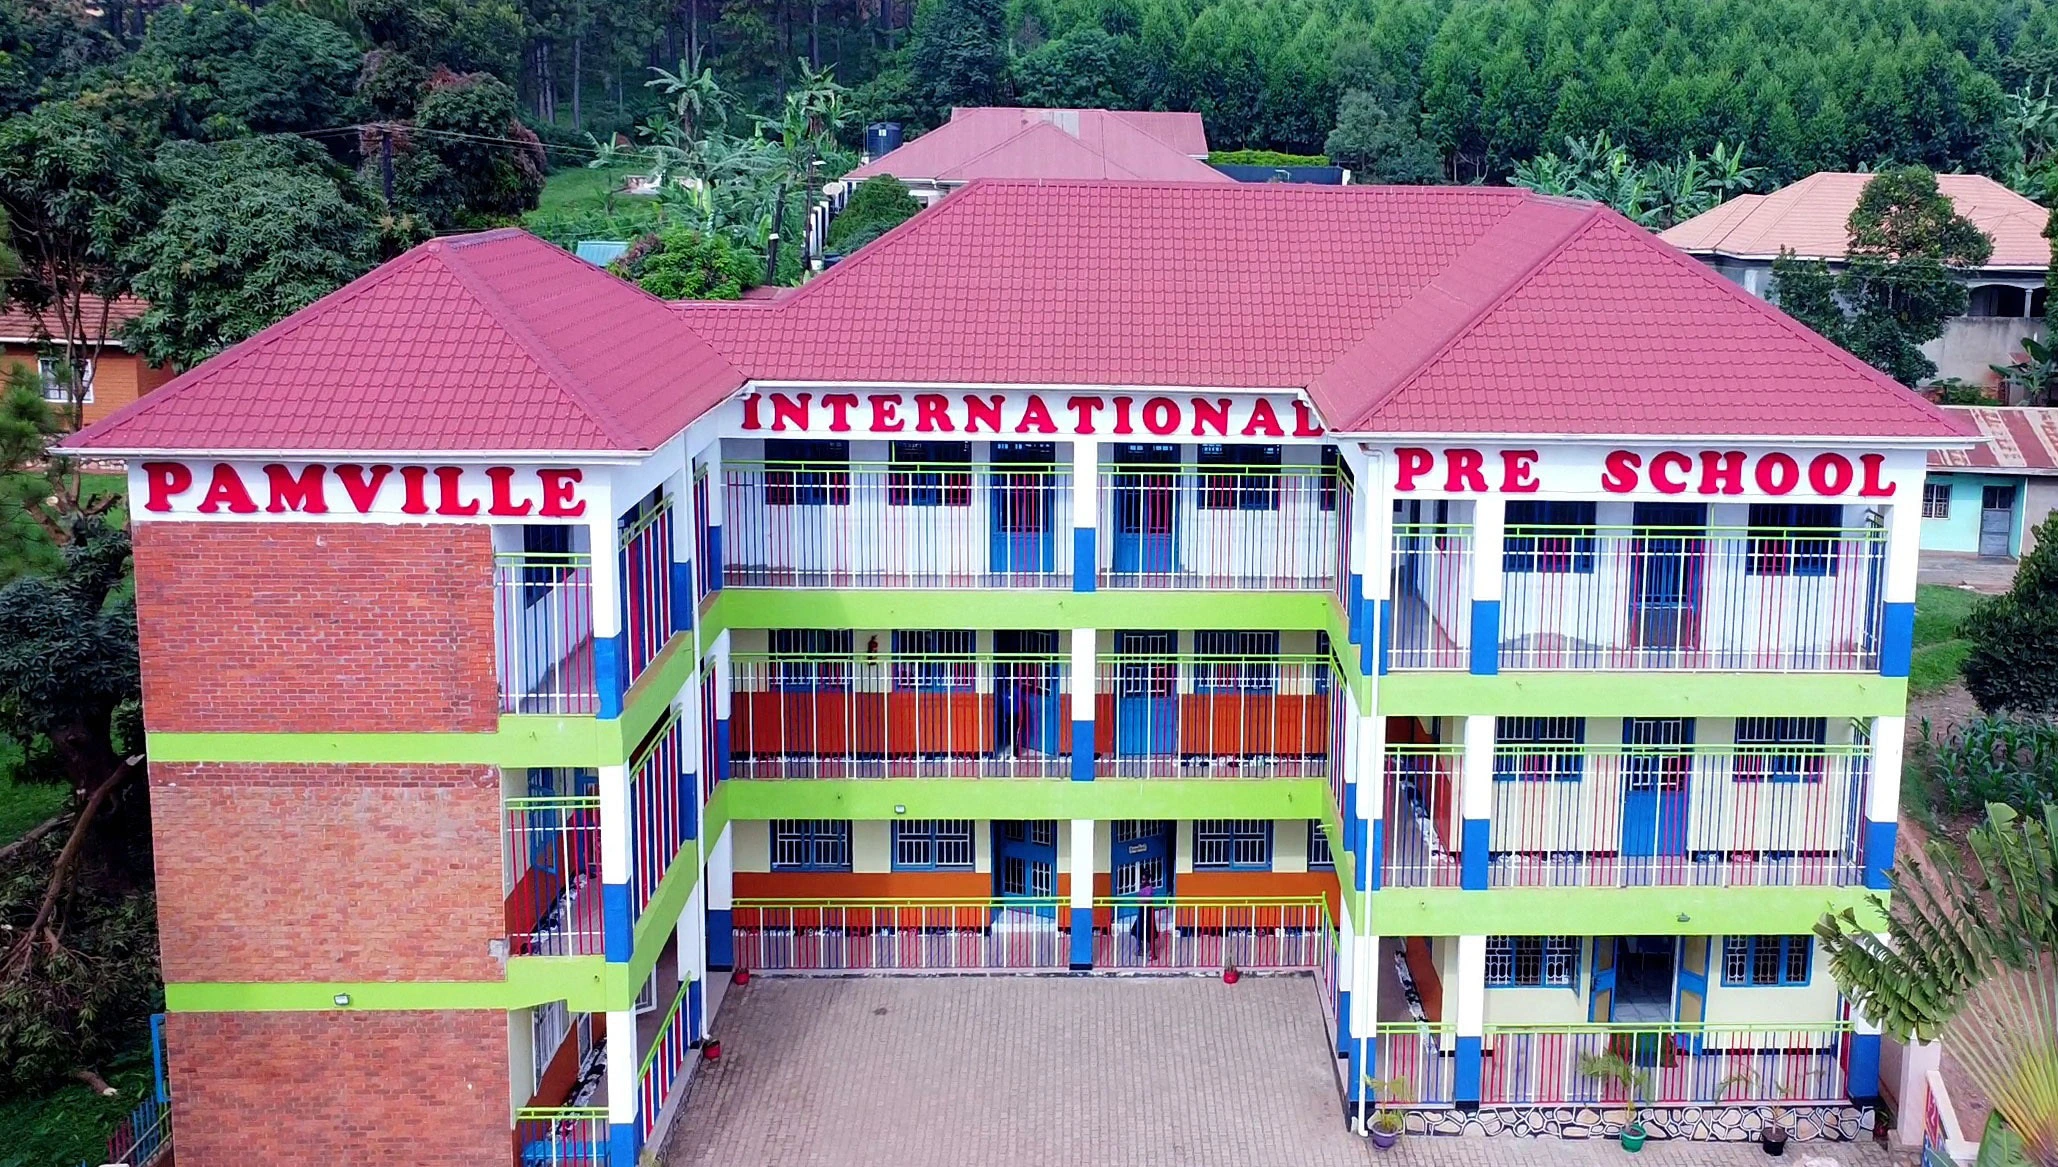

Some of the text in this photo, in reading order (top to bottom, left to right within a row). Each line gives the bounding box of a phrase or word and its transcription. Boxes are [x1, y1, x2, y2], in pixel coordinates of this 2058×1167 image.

[741, 392, 1325, 437] INTERNATIONAL
[141, 461, 587, 517] PAMVILLE
[1393, 447, 1897, 497] PRE SCHOOL
